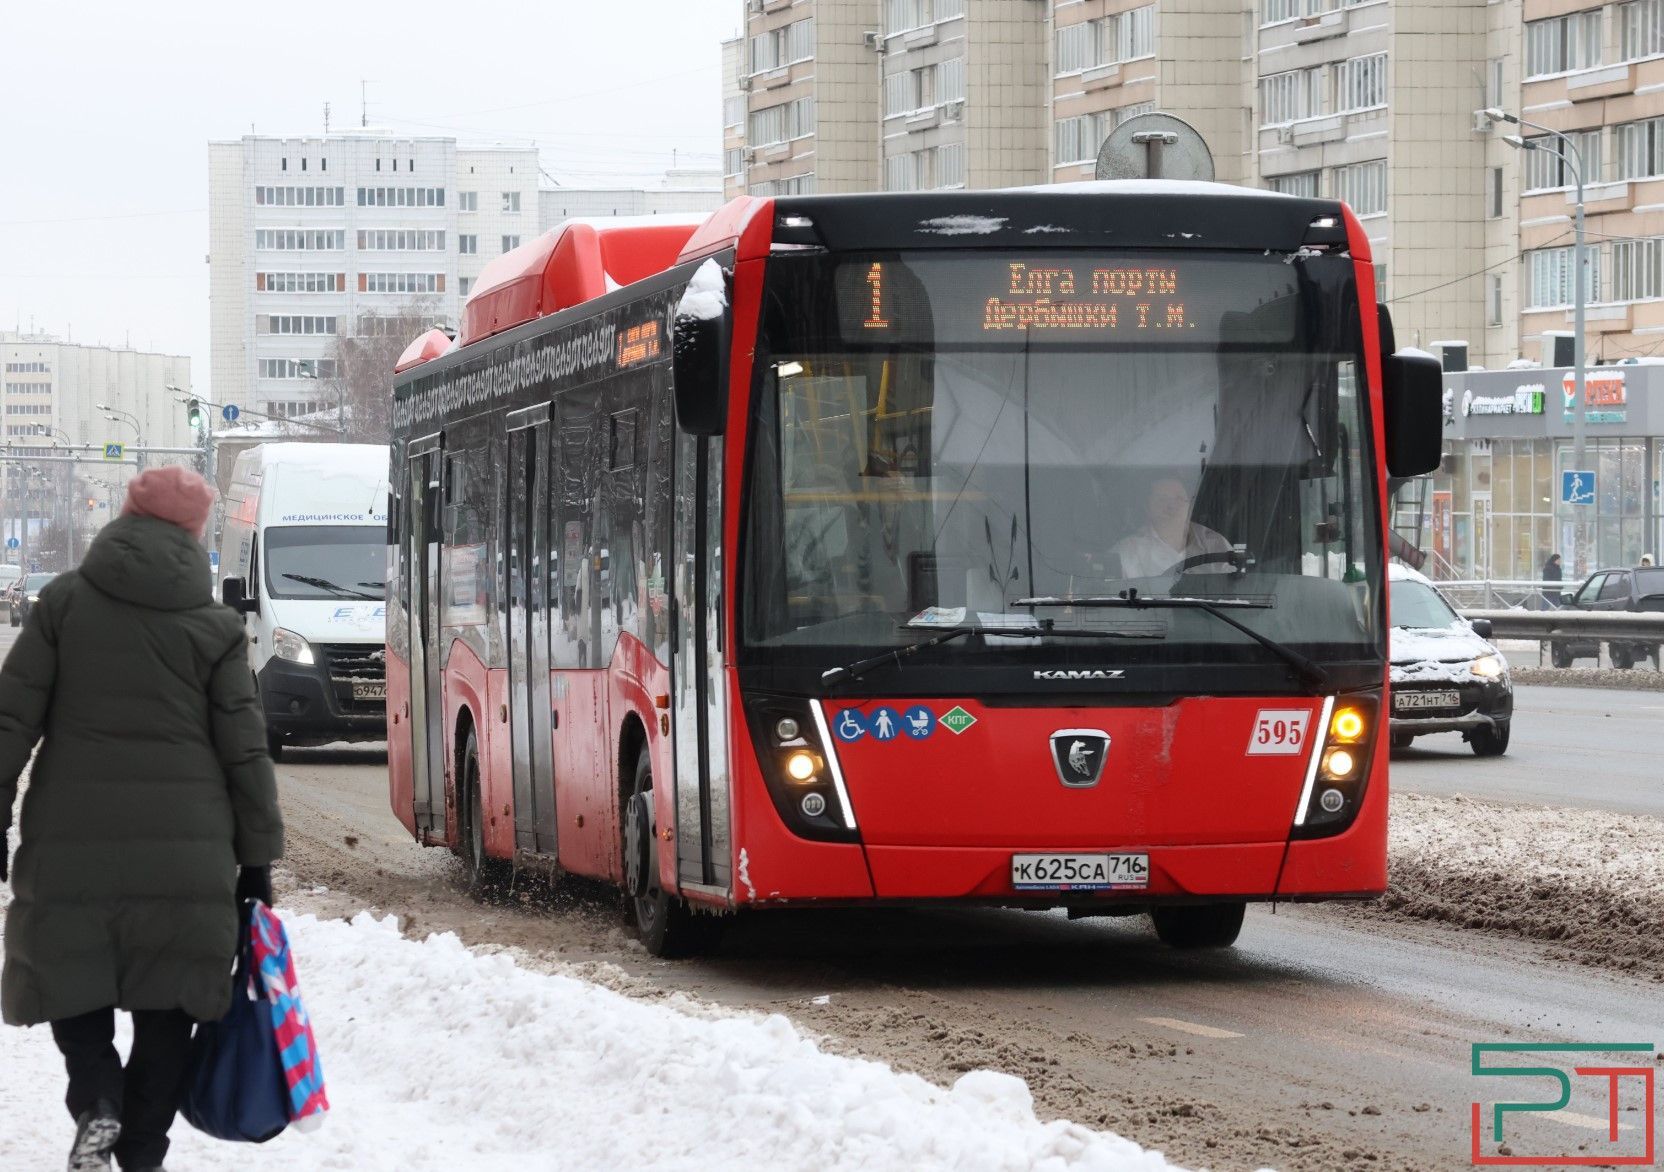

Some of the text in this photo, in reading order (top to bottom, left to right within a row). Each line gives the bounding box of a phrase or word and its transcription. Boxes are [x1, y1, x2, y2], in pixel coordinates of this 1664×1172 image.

[1009, 263, 1075, 294] Елга
[864, 262, 889, 328] 1
[282, 513, 364, 522] МЕДИЦИНСКОЕ
[1033, 669, 1126, 680] KAMAZ
[1398, 695, 1440, 707] А721НТ
[947, 715, 968, 725] КПГ
[1257, 719, 1301, 745] 595
[1020, 856, 1143, 880] К625СА 716
